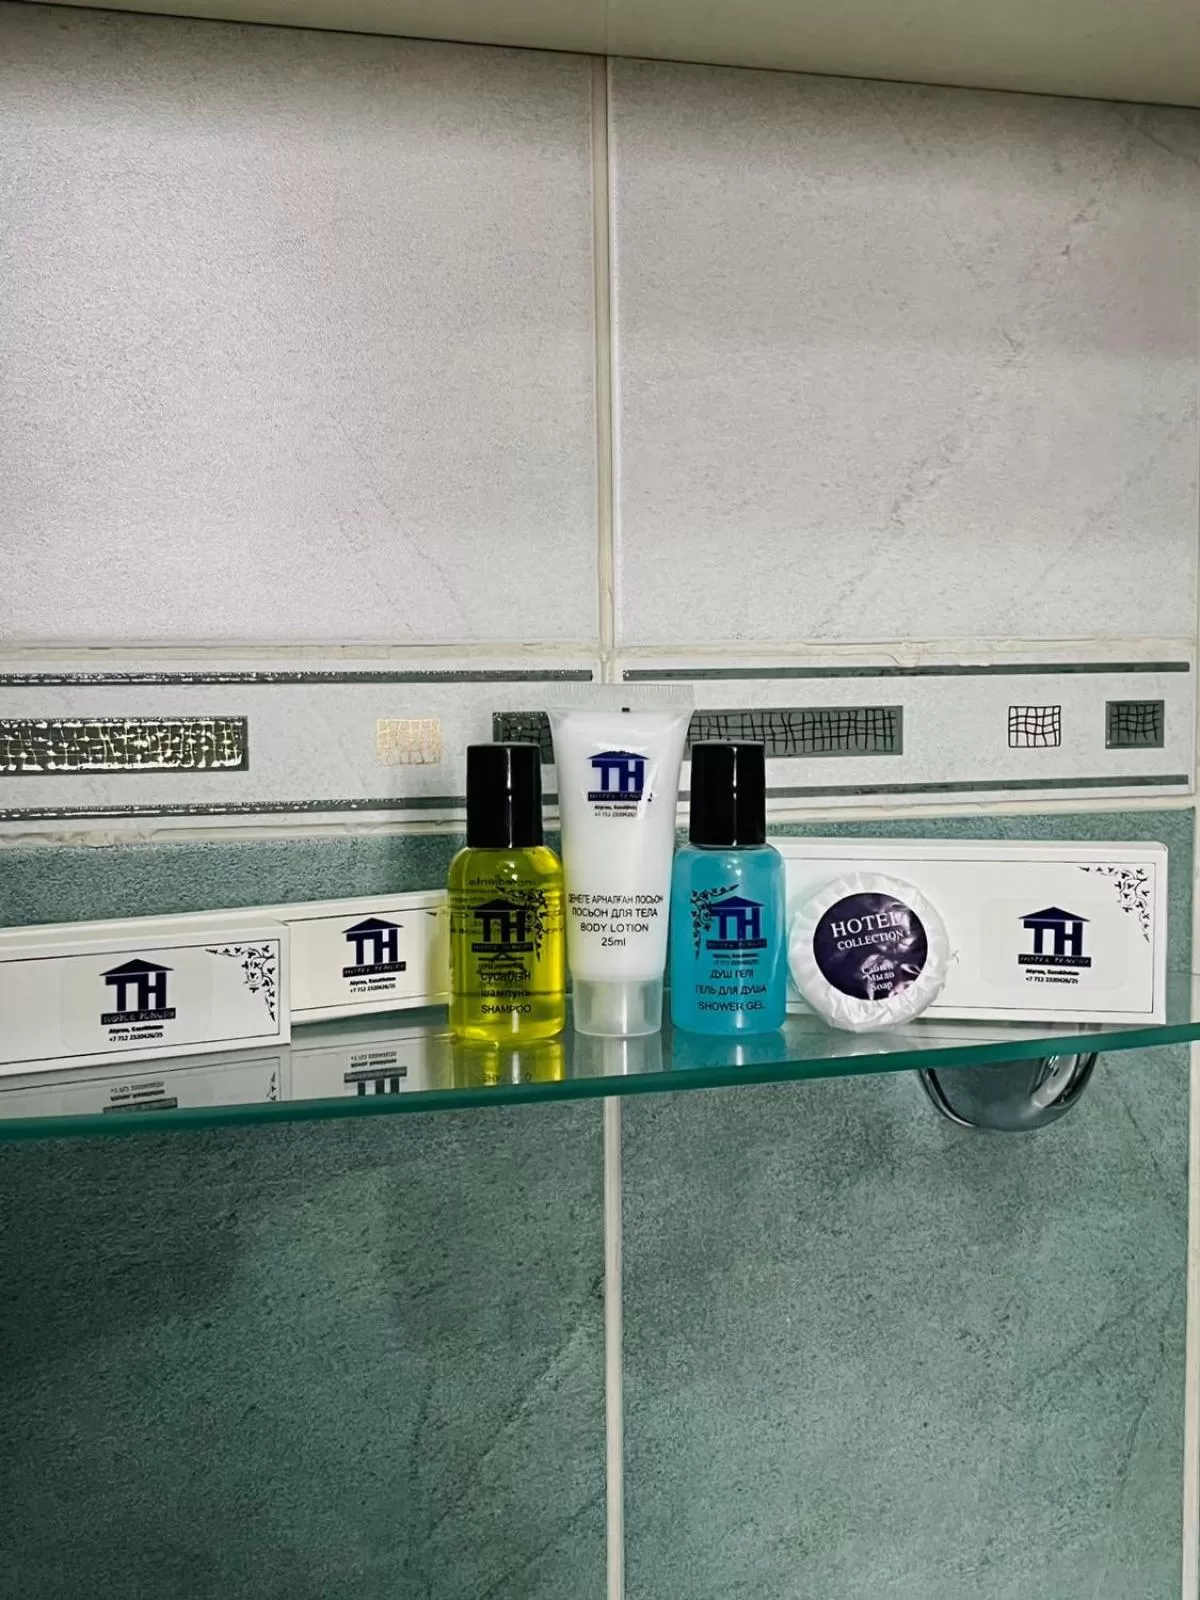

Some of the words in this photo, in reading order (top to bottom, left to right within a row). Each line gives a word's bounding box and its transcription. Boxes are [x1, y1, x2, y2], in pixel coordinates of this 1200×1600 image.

[591, 760, 644, 792] TH
[572, 907, 609, 917] ЛОСЬОН
[611, 908, 633, 919] ДЛЯ
[635, 908, 658, 917] ТЕЛА
[580, 923, 607, 932] BODY
[610, 923, 649, 932] LOTION
[830, 911, 902, 939] HOTEL
[601, 937, 626, 946] 25ml
[837, 929, 905, 950] COLLECTION
[1023, 920, 1083, 957] TH
[346, 928, 398, 965] TH
[710, 969, 733, 979] ДУШ
[105, 971, 167, 1012] TH
[695, 985, 717, 995] ГЕЛЬ
[718, 985, 738, 996] ДЛЯ
[740, 984, 768, 995] ДУША
[481, 1004, 531, 1014] SHAMPOO
[699, 1001, 745, 1012] SHOWER
[746, 1000, 766, 1011] GEL
